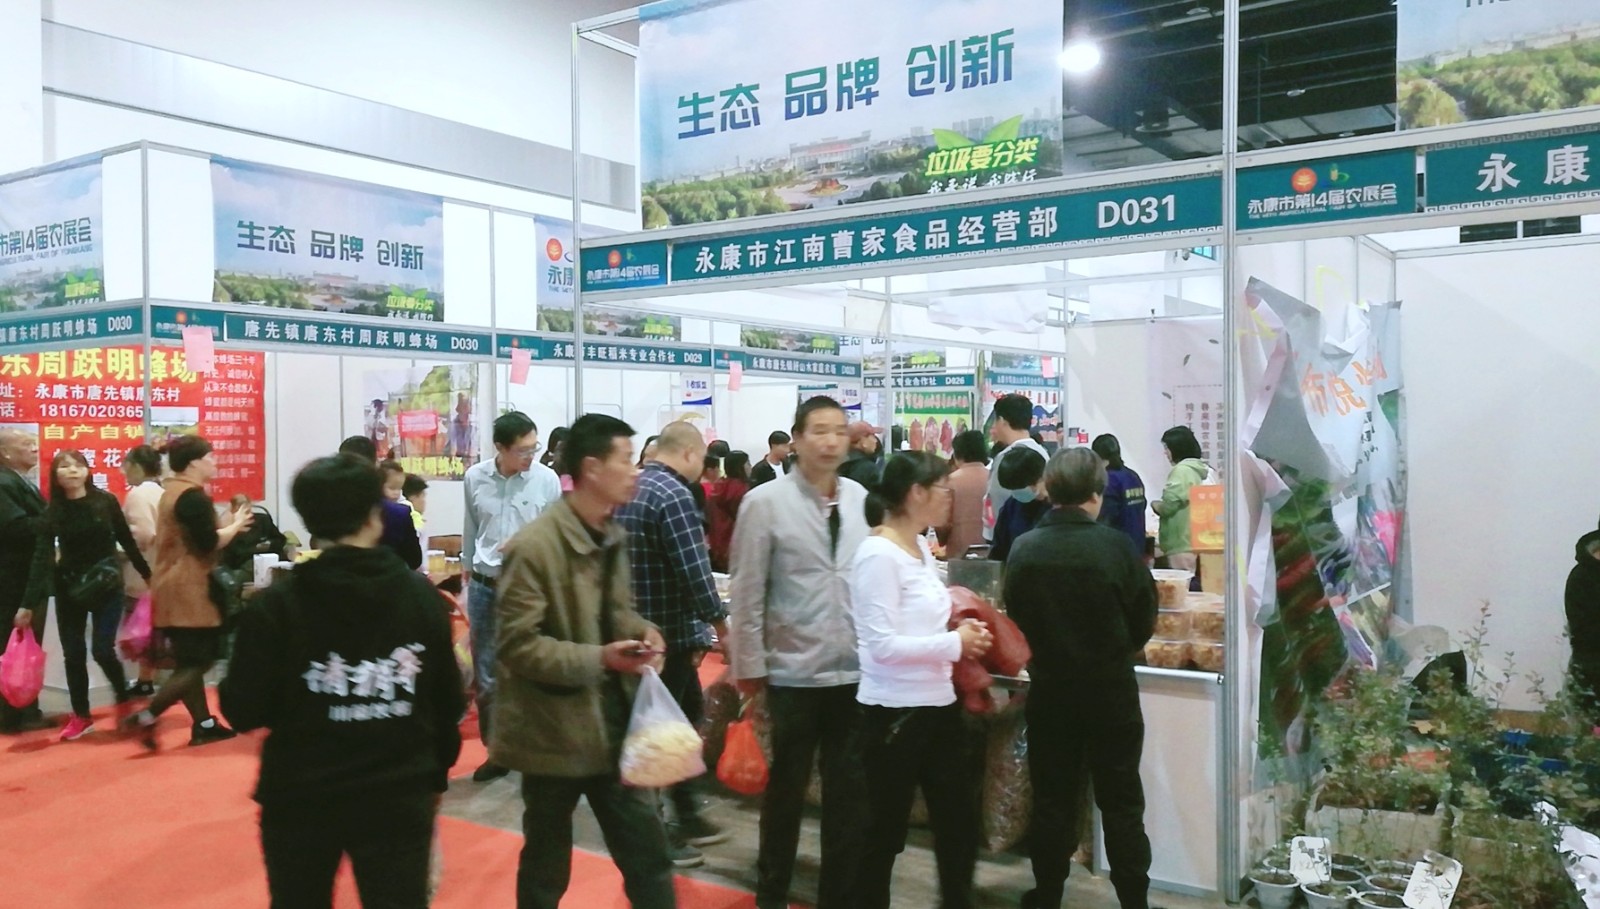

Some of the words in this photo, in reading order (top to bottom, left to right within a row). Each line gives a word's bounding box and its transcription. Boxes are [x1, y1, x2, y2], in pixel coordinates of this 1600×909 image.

[677, 83, 761, 140] 生态
[784, 56, 880, 121] 品牌
[905, 28, 1015, 98] 创新
[925, 137, 1040, 177] 垃圾要分类
[1476, 143, 1590, 193] 永康
[1248, 183, 1398, 214] 永康市第14届农展会
[236, 219, 296, 255] 生态
[310, 229, 364, 263] 品牌
[376, 239, 424, 270] 创新
[694, 205, 1059, 274] 永康市江南曹家食品经营部
[1097, 193, 1176, 230] D031
[107, 315, 133, 332] D030
[244, 319, 439, 351] 唐先镇唐东村周跃明蜂场
[450, 335, 479, 351] D030
[683, 351, 703, 363] D029
[39, 404, 143, 418] 18167020365
